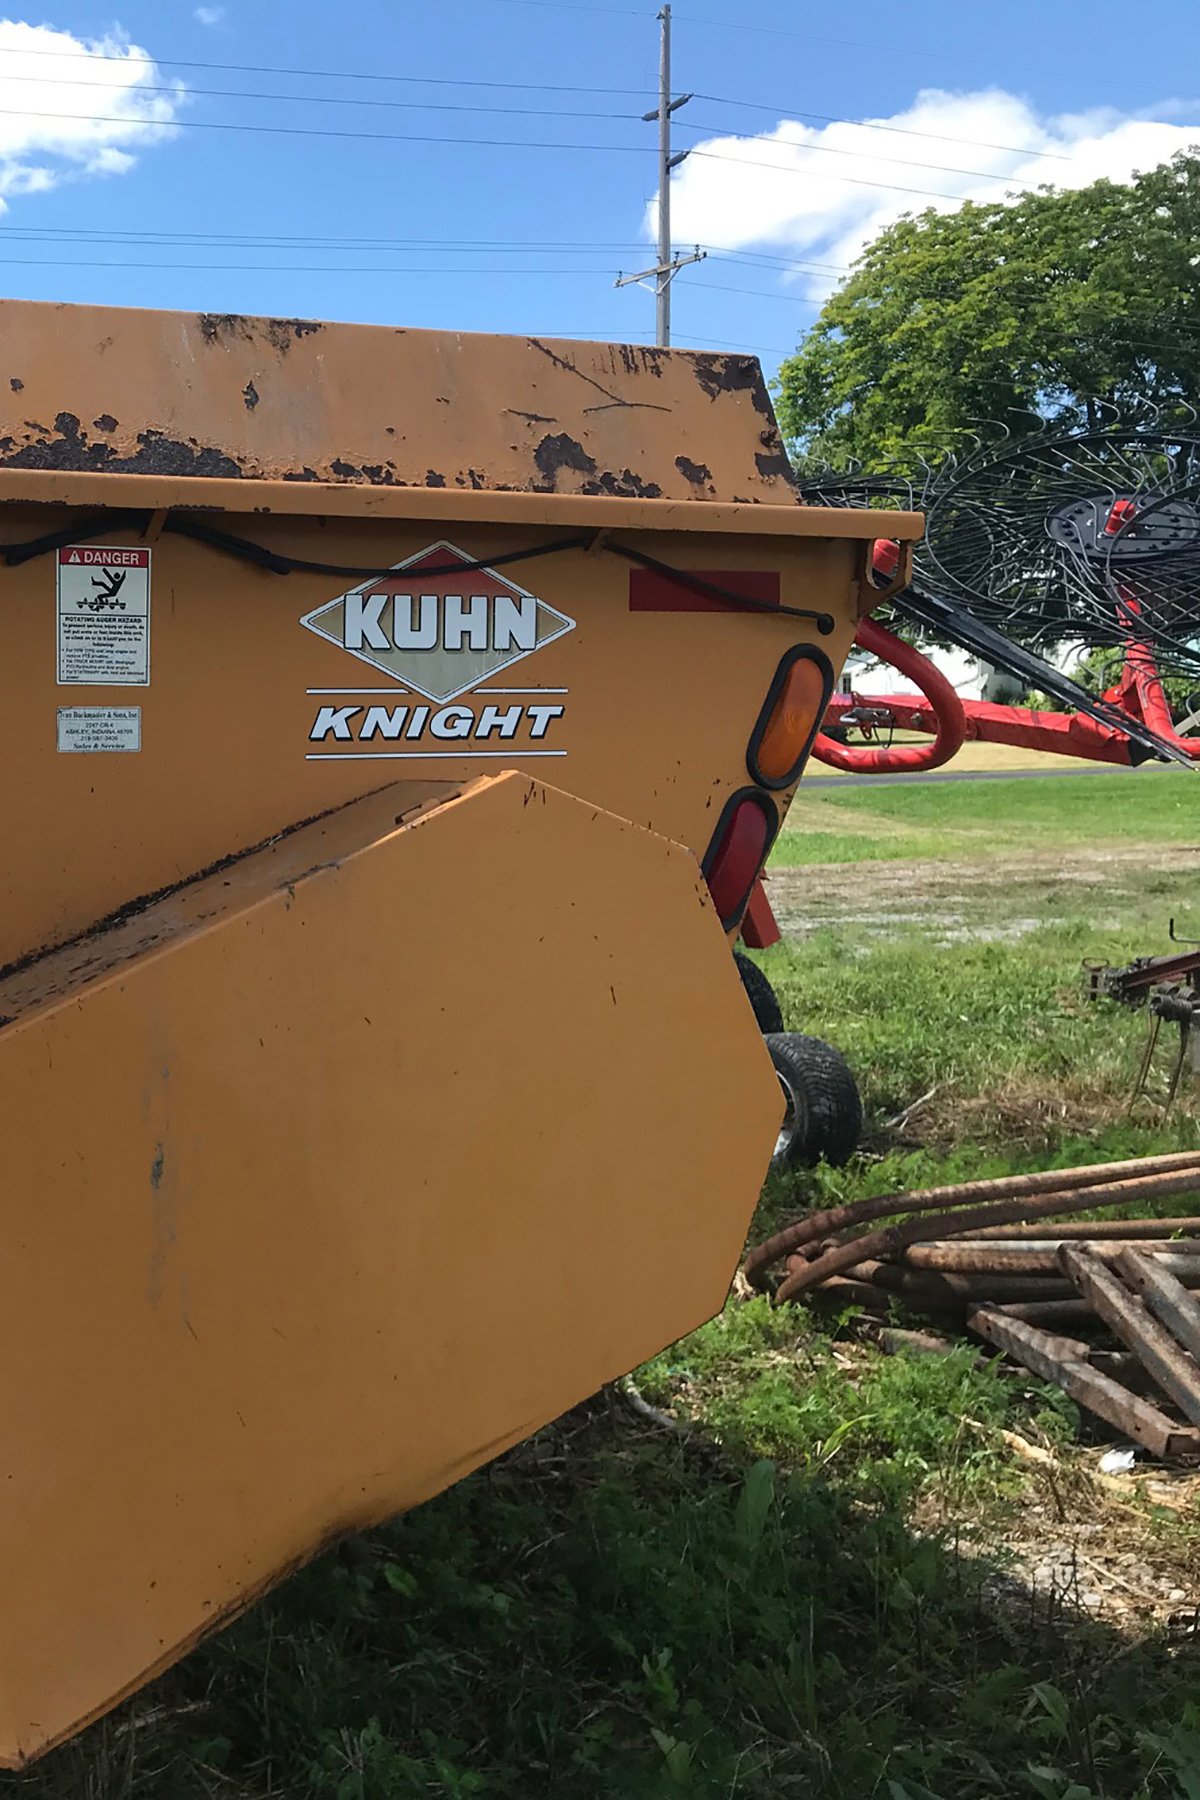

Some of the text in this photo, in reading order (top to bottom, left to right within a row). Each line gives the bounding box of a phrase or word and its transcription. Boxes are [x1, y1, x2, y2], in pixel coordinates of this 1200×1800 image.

[84, 551, 139, 565] DANGER
[344, 594, 537, 650] KUHN
[309, 705, 565, 741] KNIGHT
